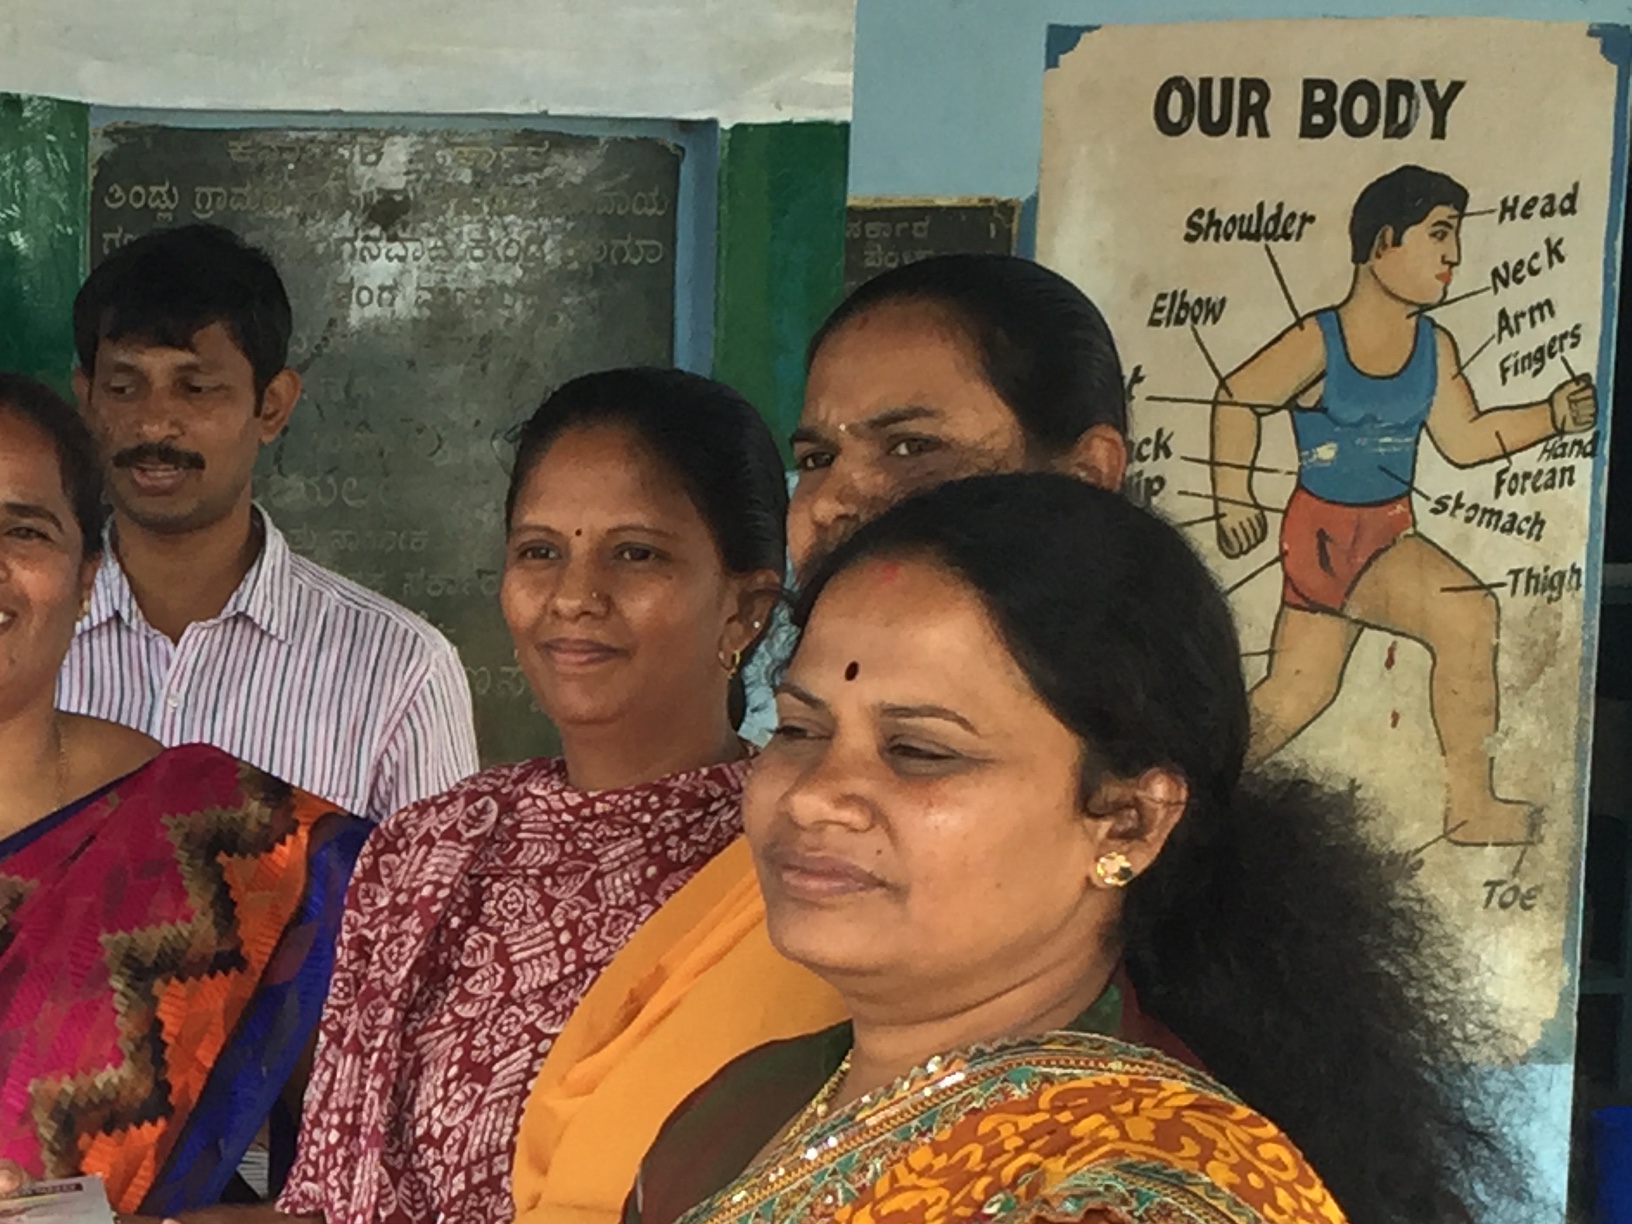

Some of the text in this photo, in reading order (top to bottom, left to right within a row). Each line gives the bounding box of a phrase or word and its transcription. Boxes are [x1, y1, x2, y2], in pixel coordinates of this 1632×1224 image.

[1154, 76, 1466, 140] OUR BODY
[1183, 200, 1316, 244] Shoulder
[1498, 181, 1581, 226] Head
[1489, 236, 1567, 297] Neck
[1146, 288, 1227, 329] Elbow
[1496, 298, 1557, 345] Arm
[1498, 323, 1583, 387] Fingers
[1536, 430, 1601, 463] Hand
[1506, 563, 1584, 606] Thigh
